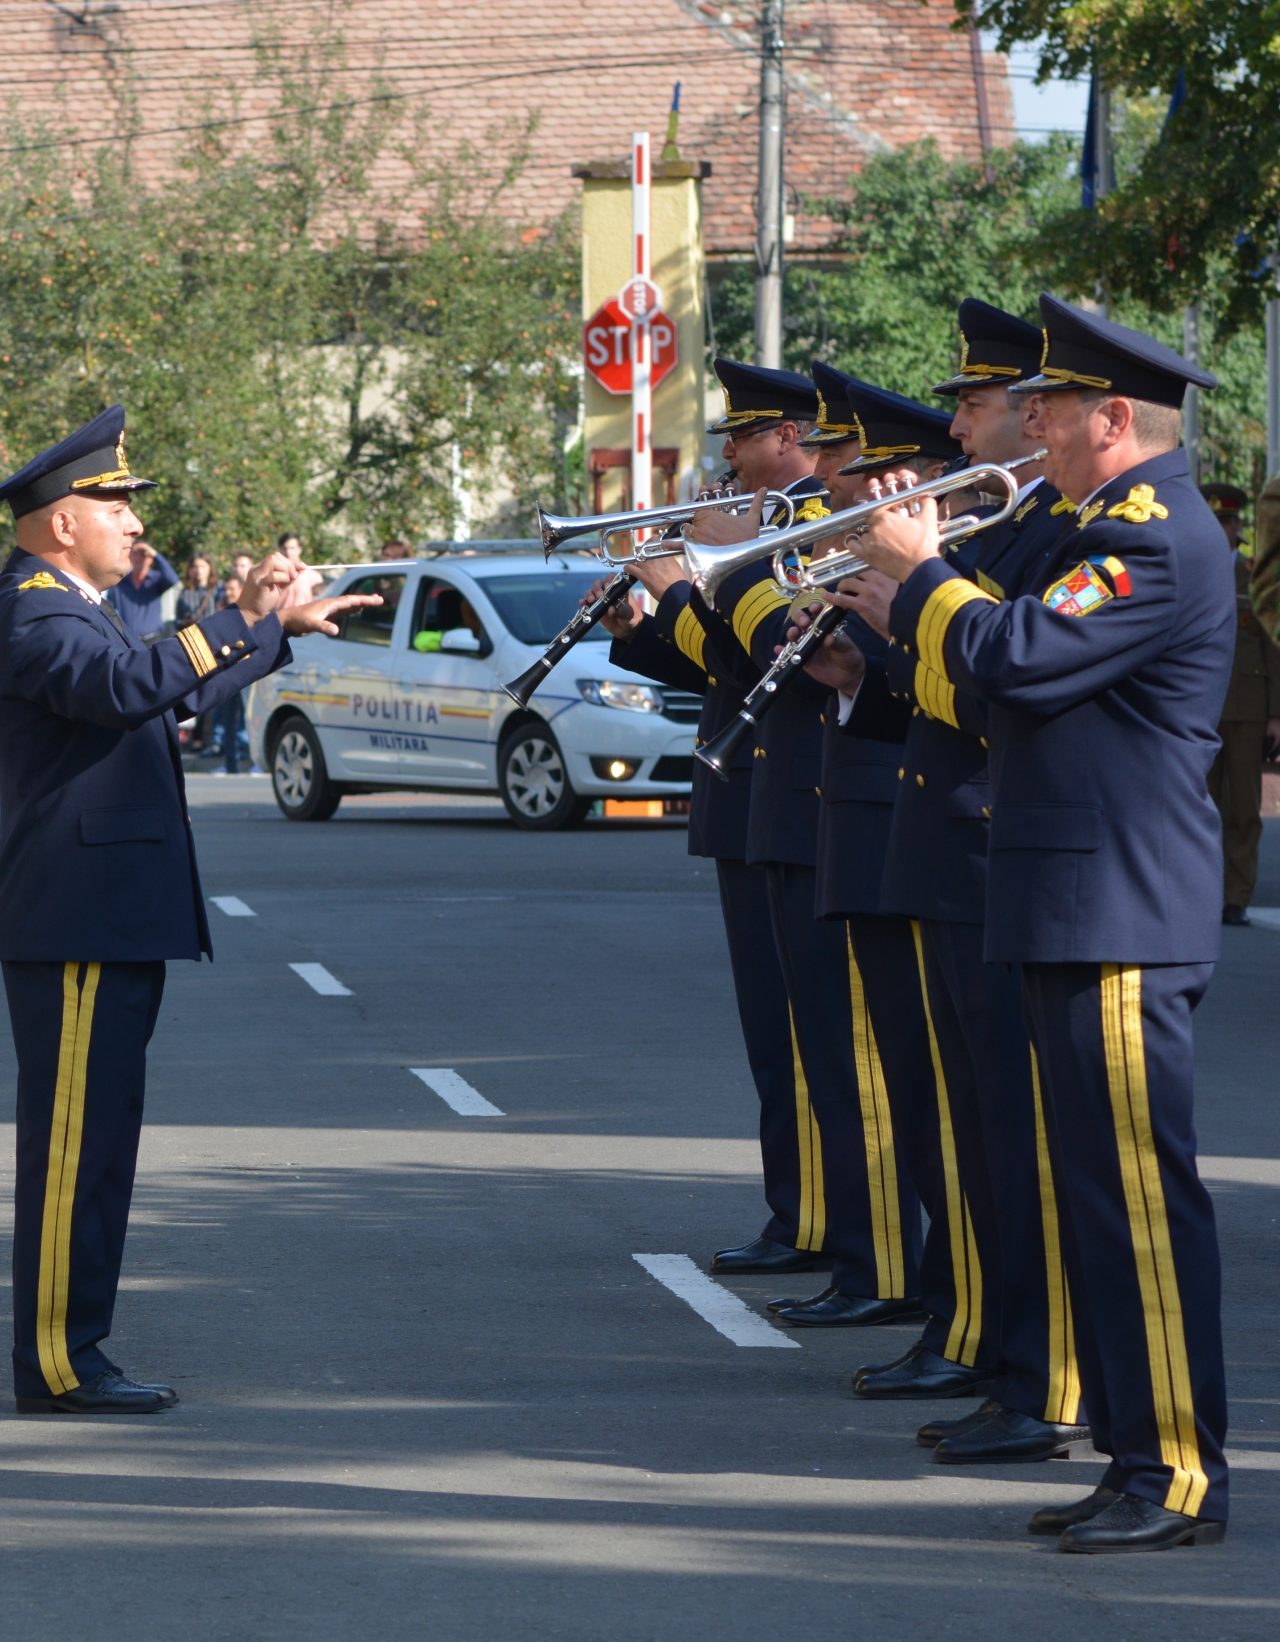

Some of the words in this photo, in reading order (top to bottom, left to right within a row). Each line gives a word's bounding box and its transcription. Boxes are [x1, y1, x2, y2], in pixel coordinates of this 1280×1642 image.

[588, 325, 672, 366] STP
[352, 692, 439, 725] POLITIA
[369, 733, 429, 752] MILITARA
